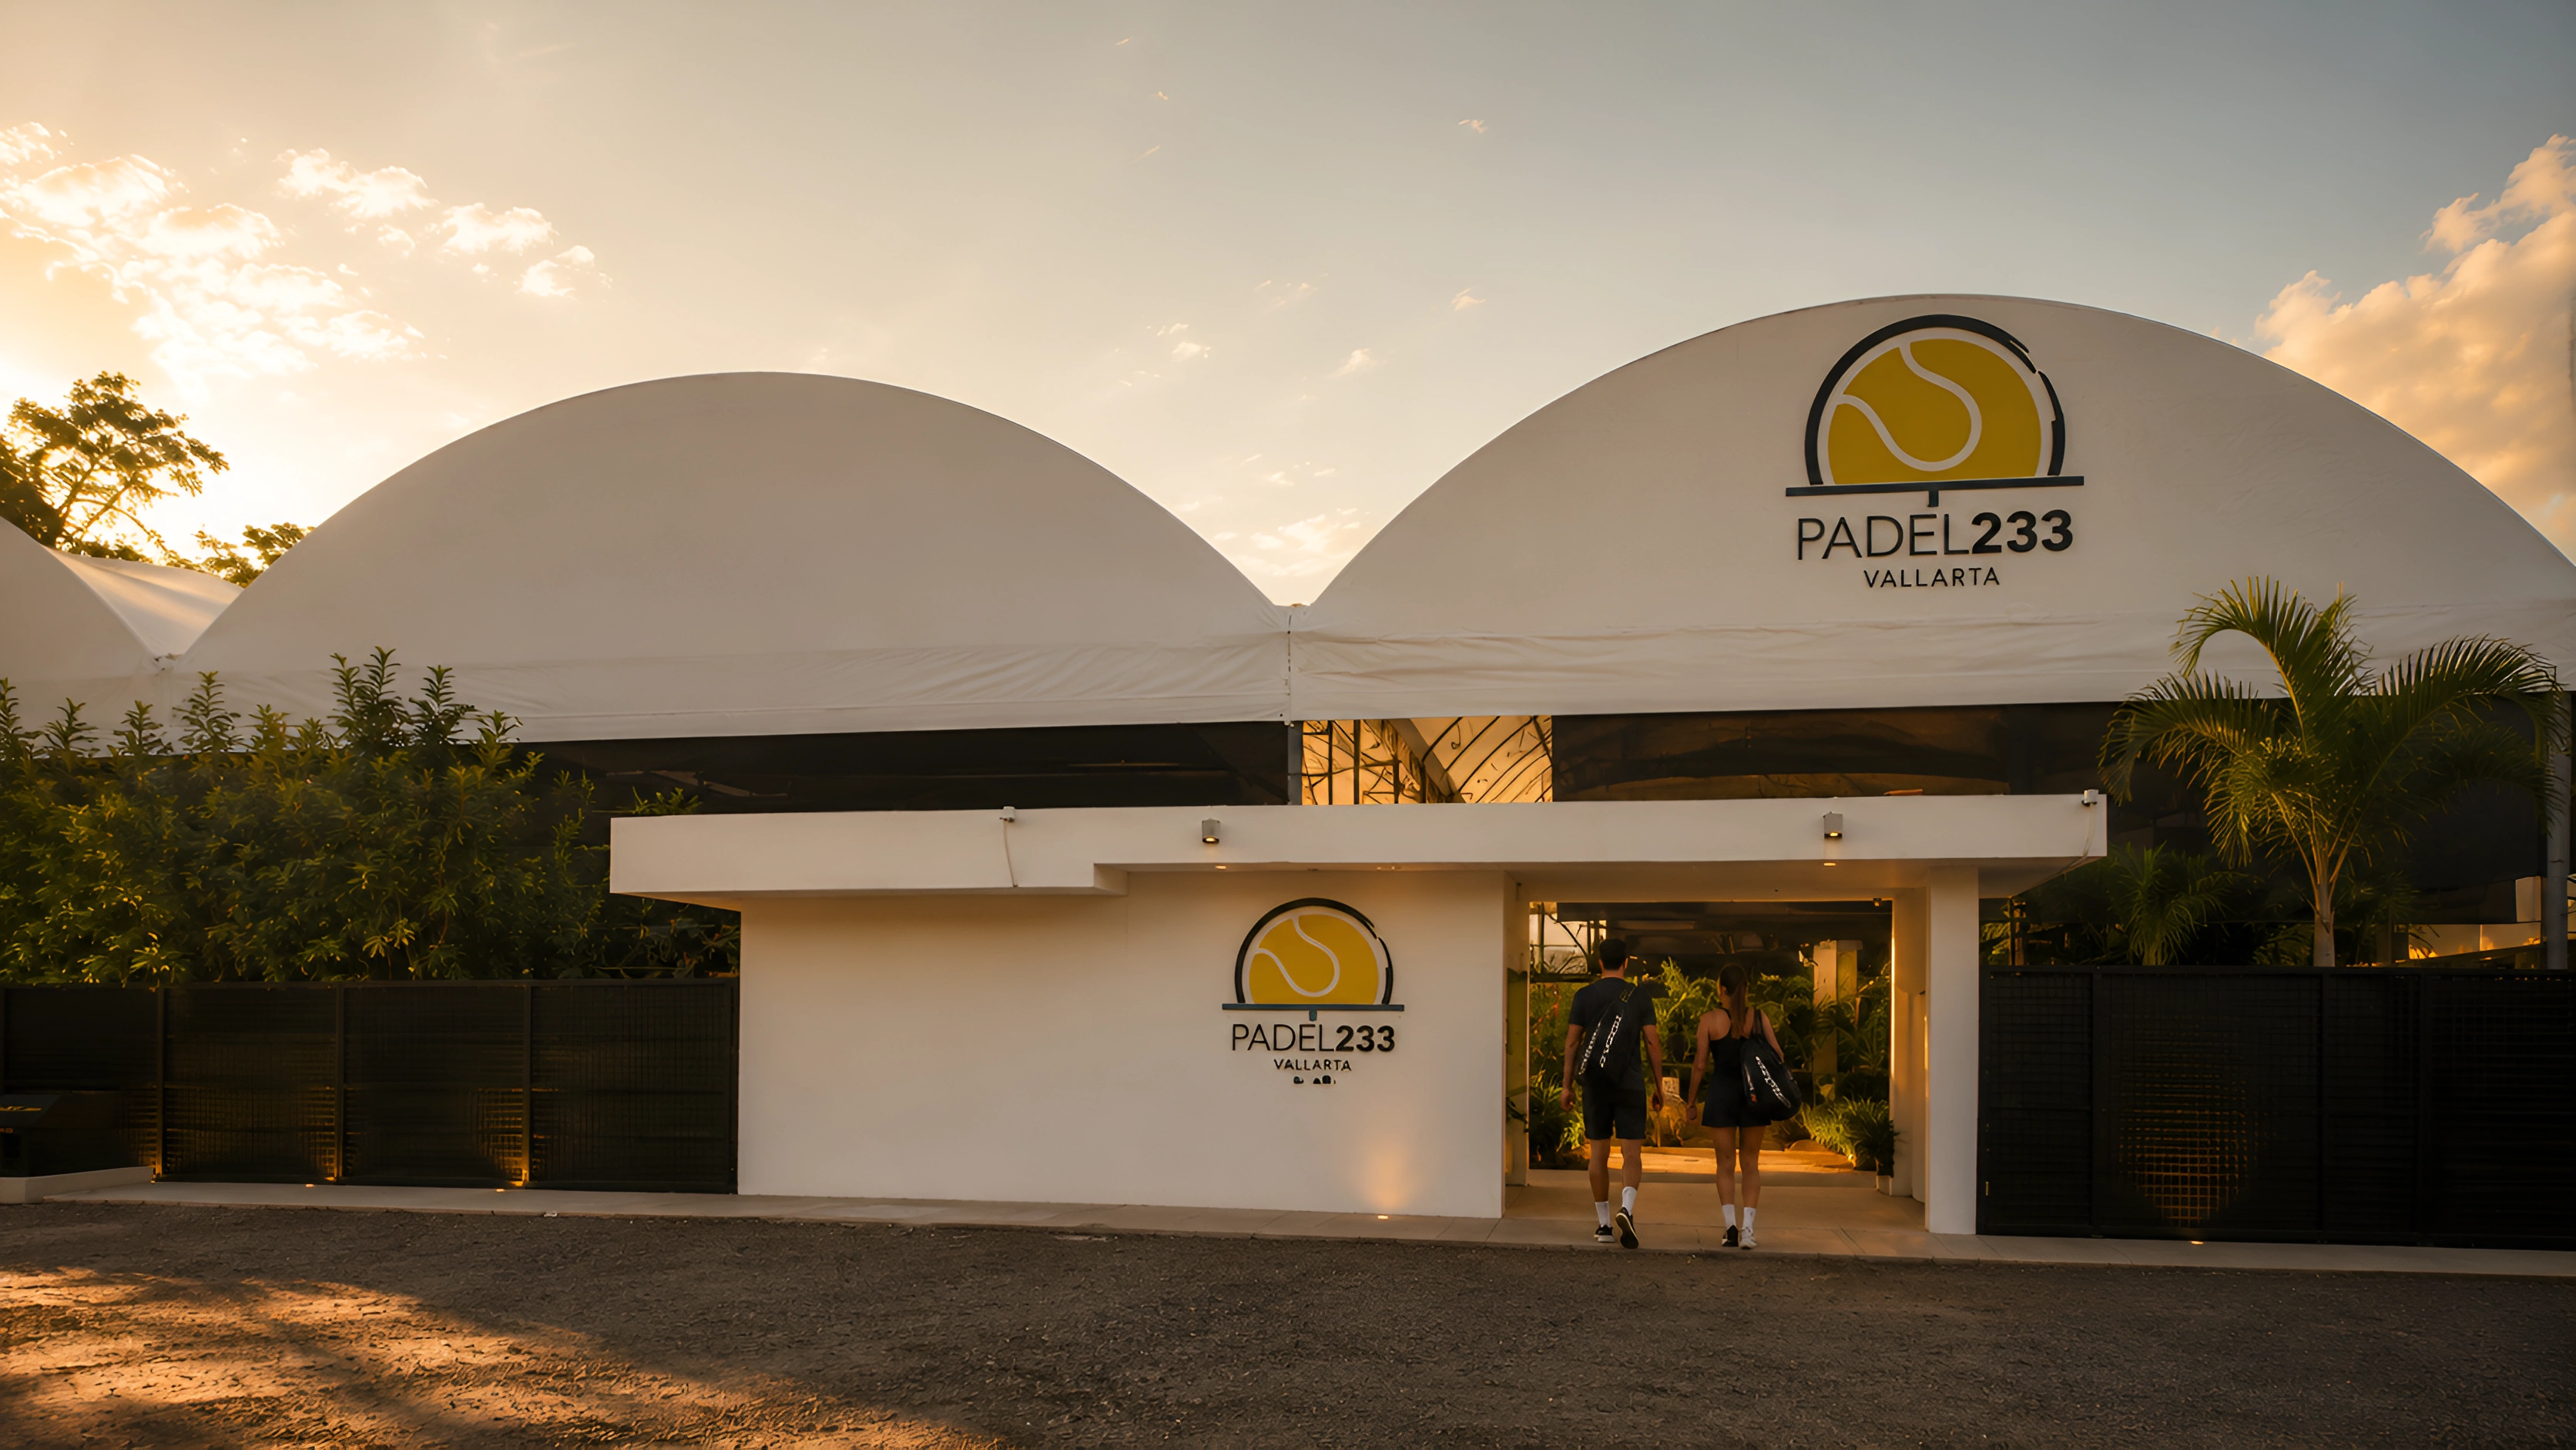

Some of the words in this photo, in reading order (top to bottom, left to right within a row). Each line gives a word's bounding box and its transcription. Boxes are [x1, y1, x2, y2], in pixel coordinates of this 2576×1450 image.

[1797, 509, 2074, 561] PADEL233
[1863, 566, 2001, 589] VALLARTA
[1232, 1023, 1396, 1053] PADEL233
[1273, 1058, 1353, 1072] VALLARTA
